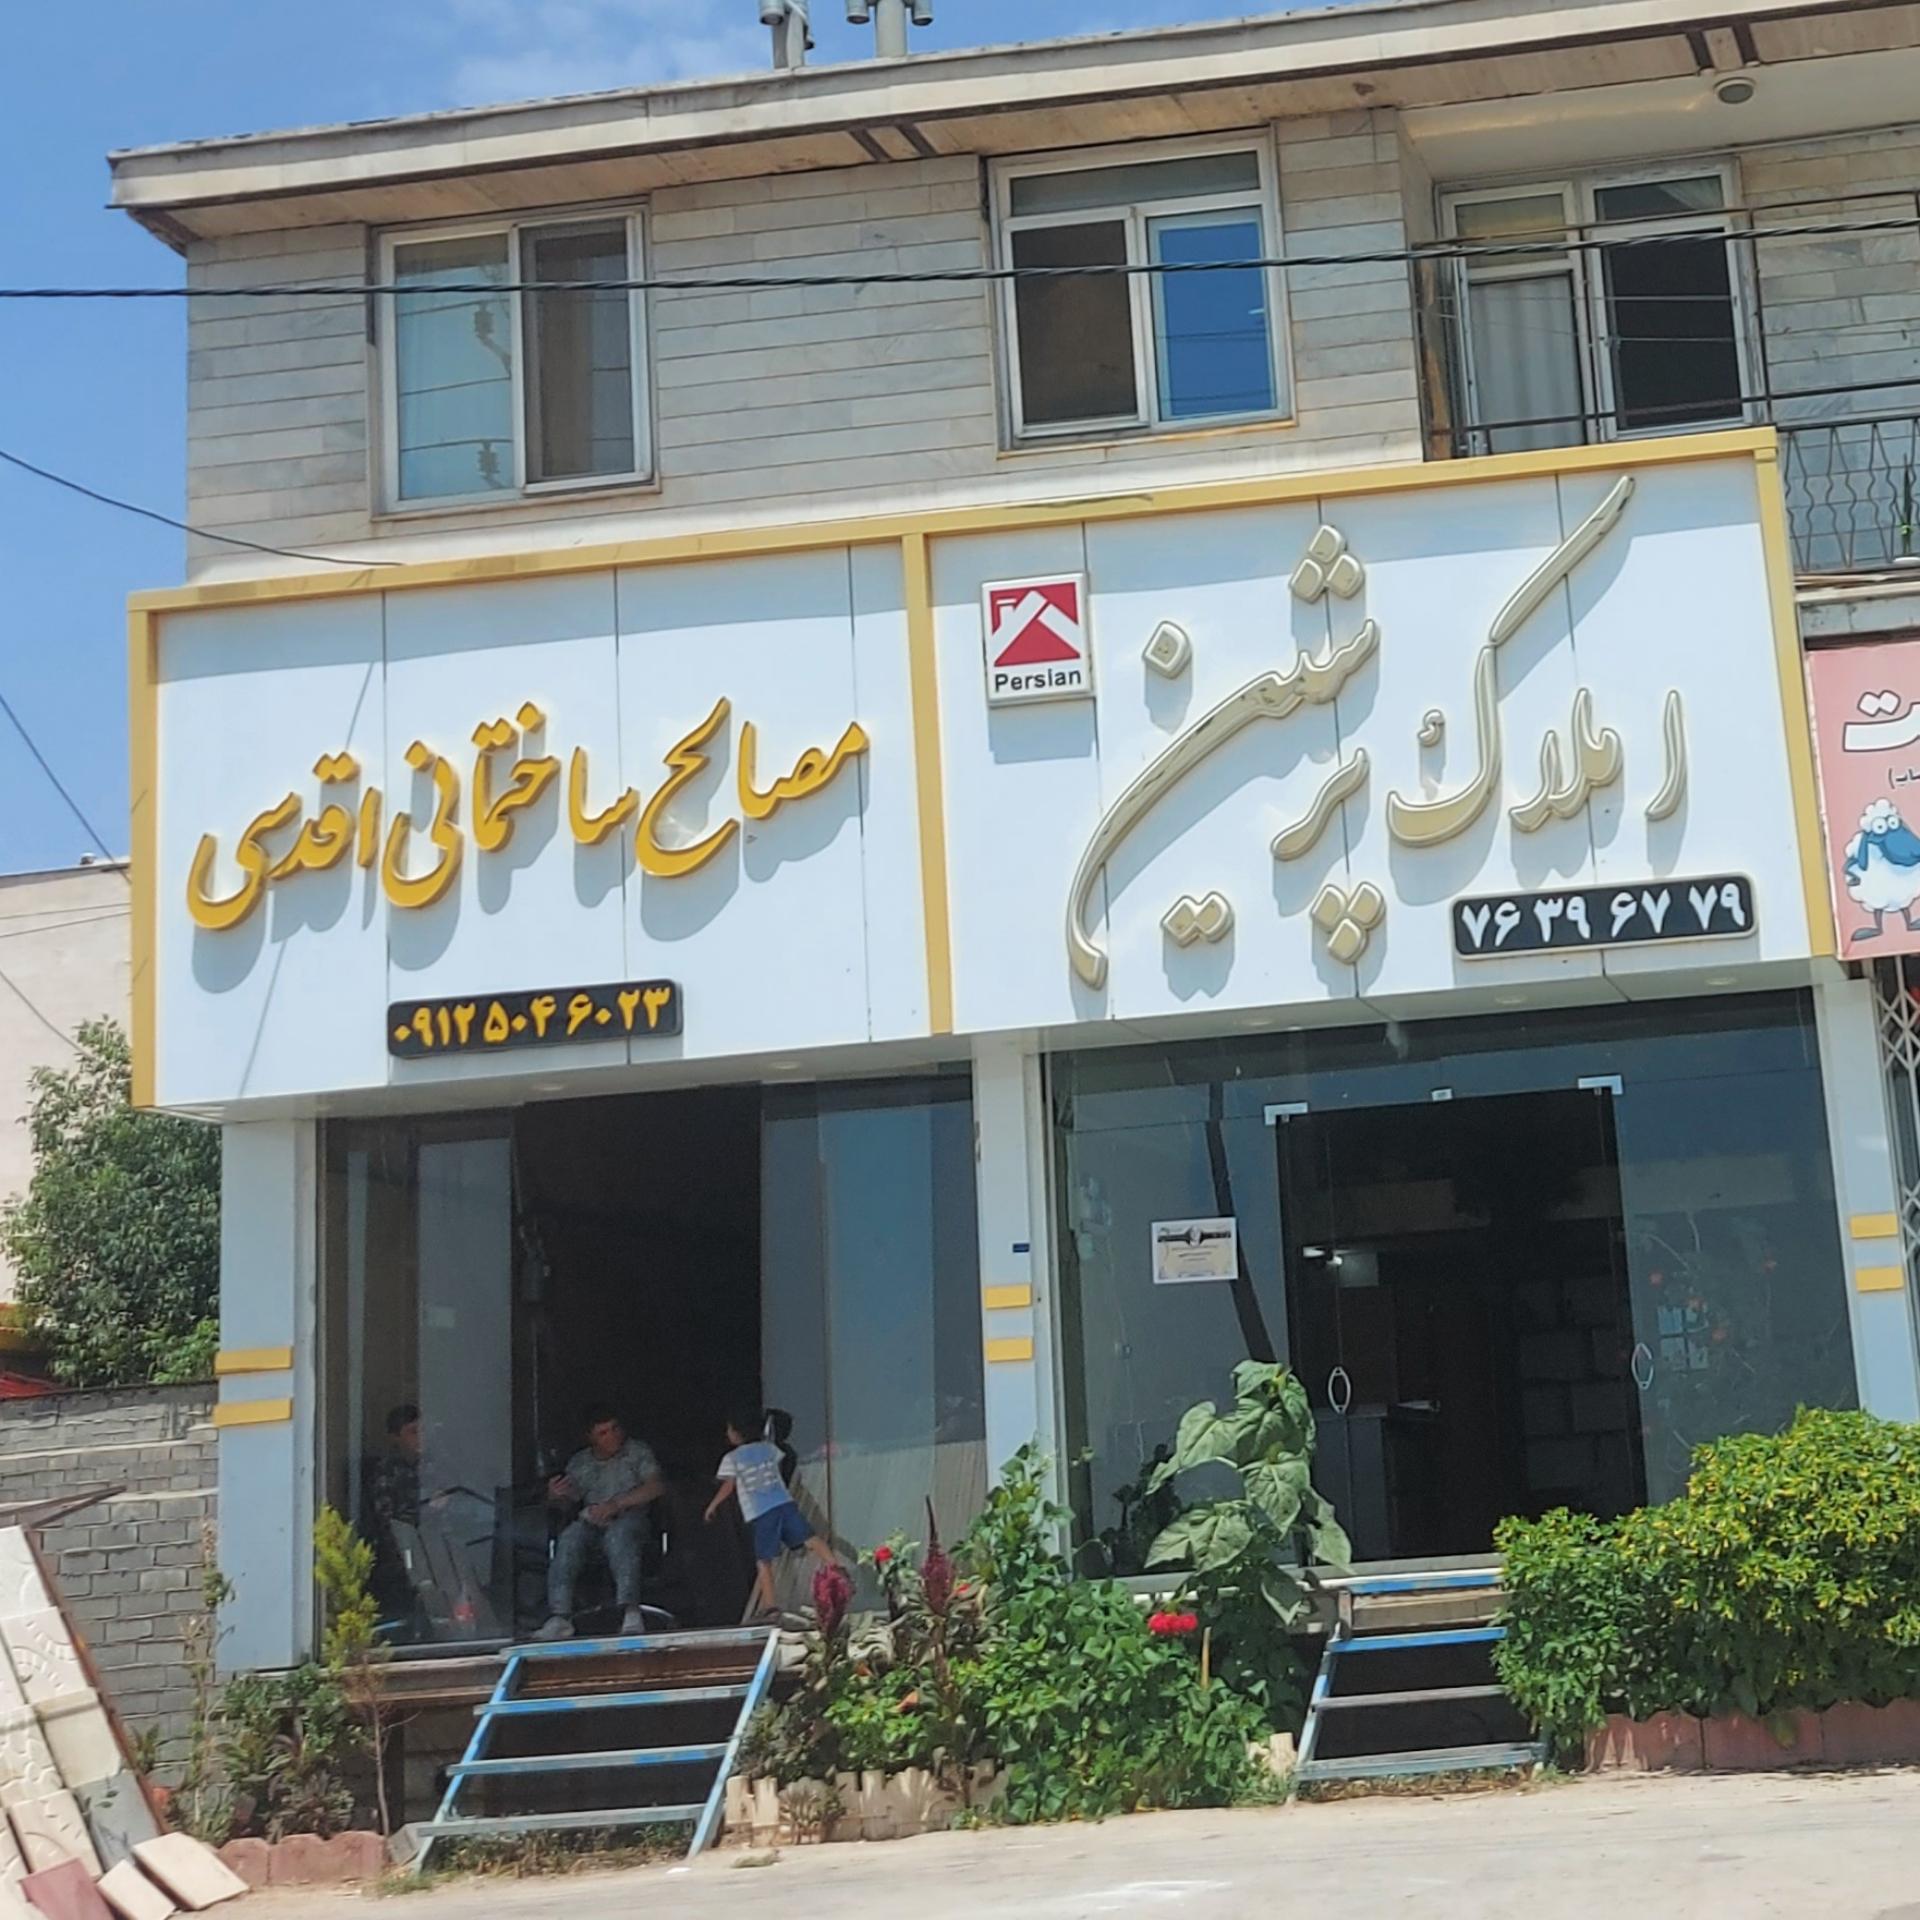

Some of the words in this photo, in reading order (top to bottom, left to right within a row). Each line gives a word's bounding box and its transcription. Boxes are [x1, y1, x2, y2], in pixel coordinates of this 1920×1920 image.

[994, 667, 1082, 693] Persian
[1386, 475, 1690, 848] املاک
[186, 752, 382, 931] اقدسی
[381, 700, 642, 910] ساختمانی
[634, 696, 870, 880] مصالح
[1066, 523, 1387, 990] پرشین
[1462, 902, 1521, 948] ۷۶
[1533, 896, 1591, 942] ۳۹
[1611, 888, 1670, 938] ۶۷
[1689, 882, 1746, 931] ۷۹
